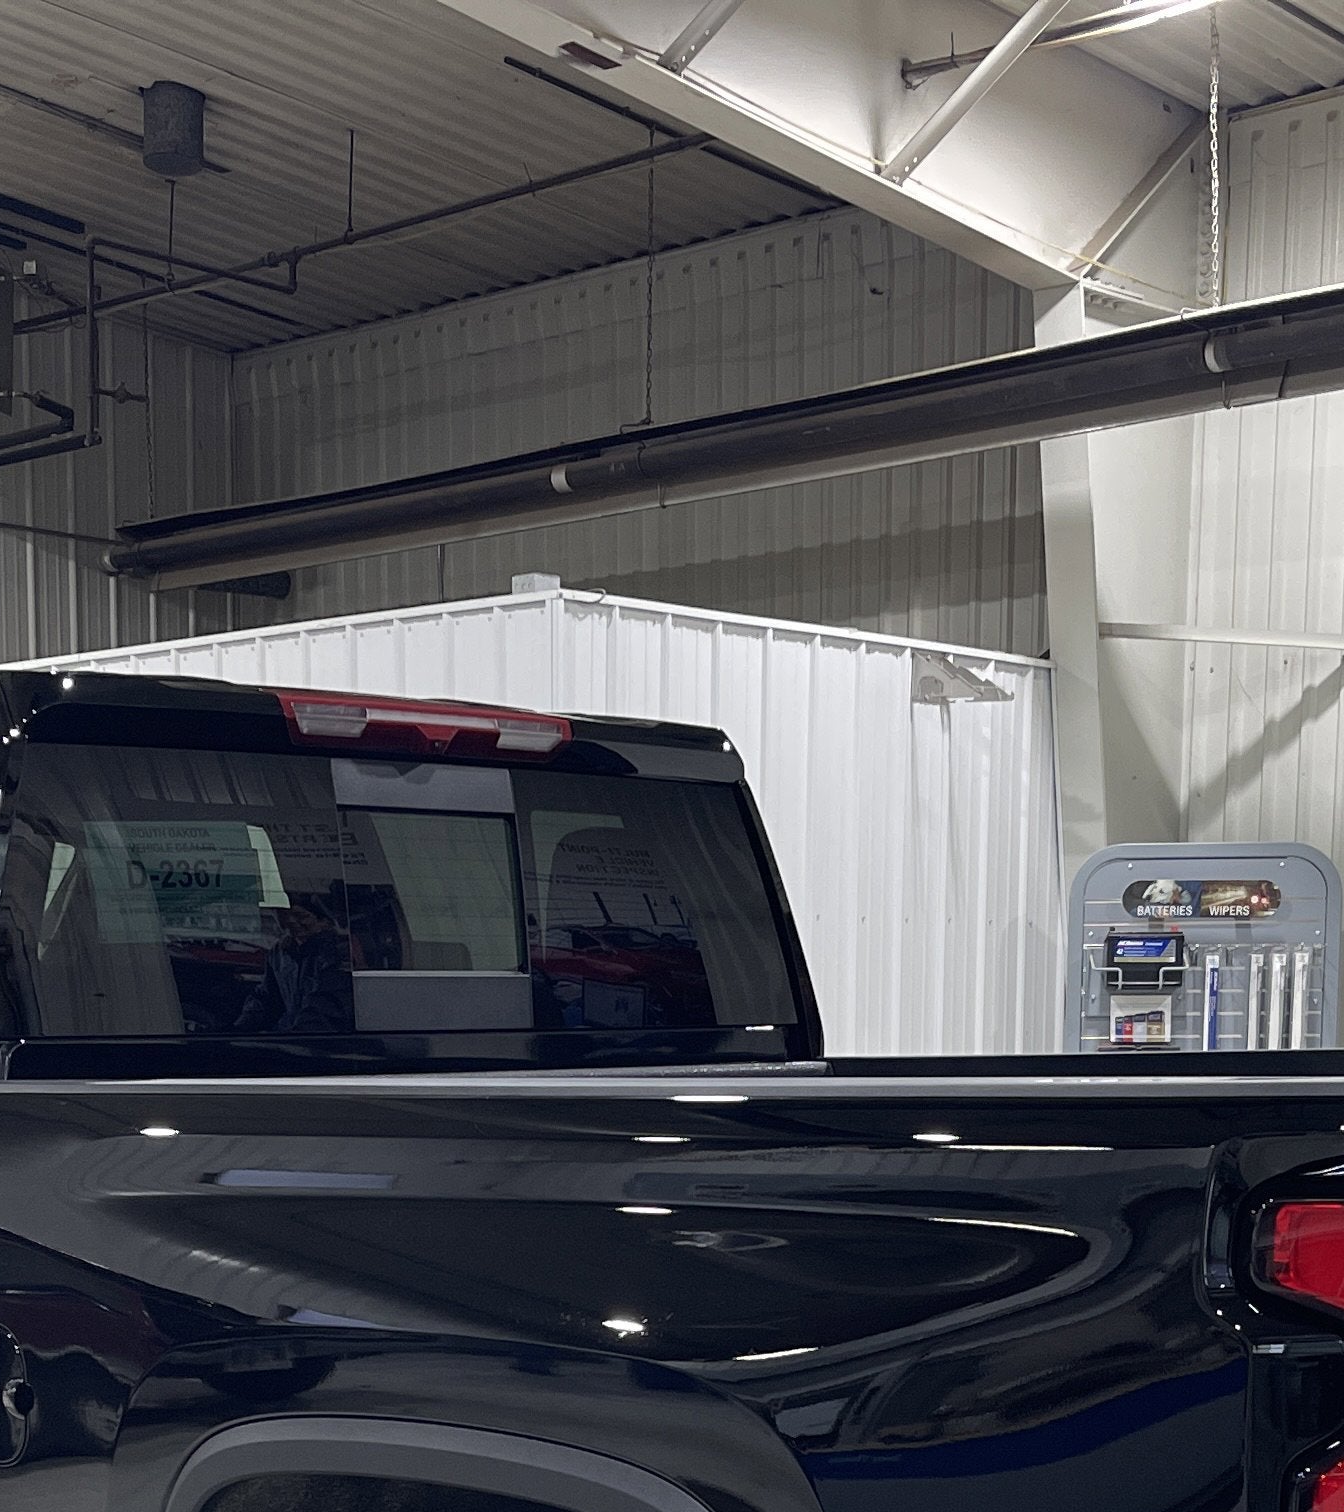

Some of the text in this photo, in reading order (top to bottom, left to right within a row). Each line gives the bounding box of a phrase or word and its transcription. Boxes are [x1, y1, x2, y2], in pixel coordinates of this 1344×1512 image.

[169, 827, 210, 839] DAKOTA
[127, 859, 225, 889] D-2367
[1136, 905, 1250, 917] BATTERIES WIPERS
